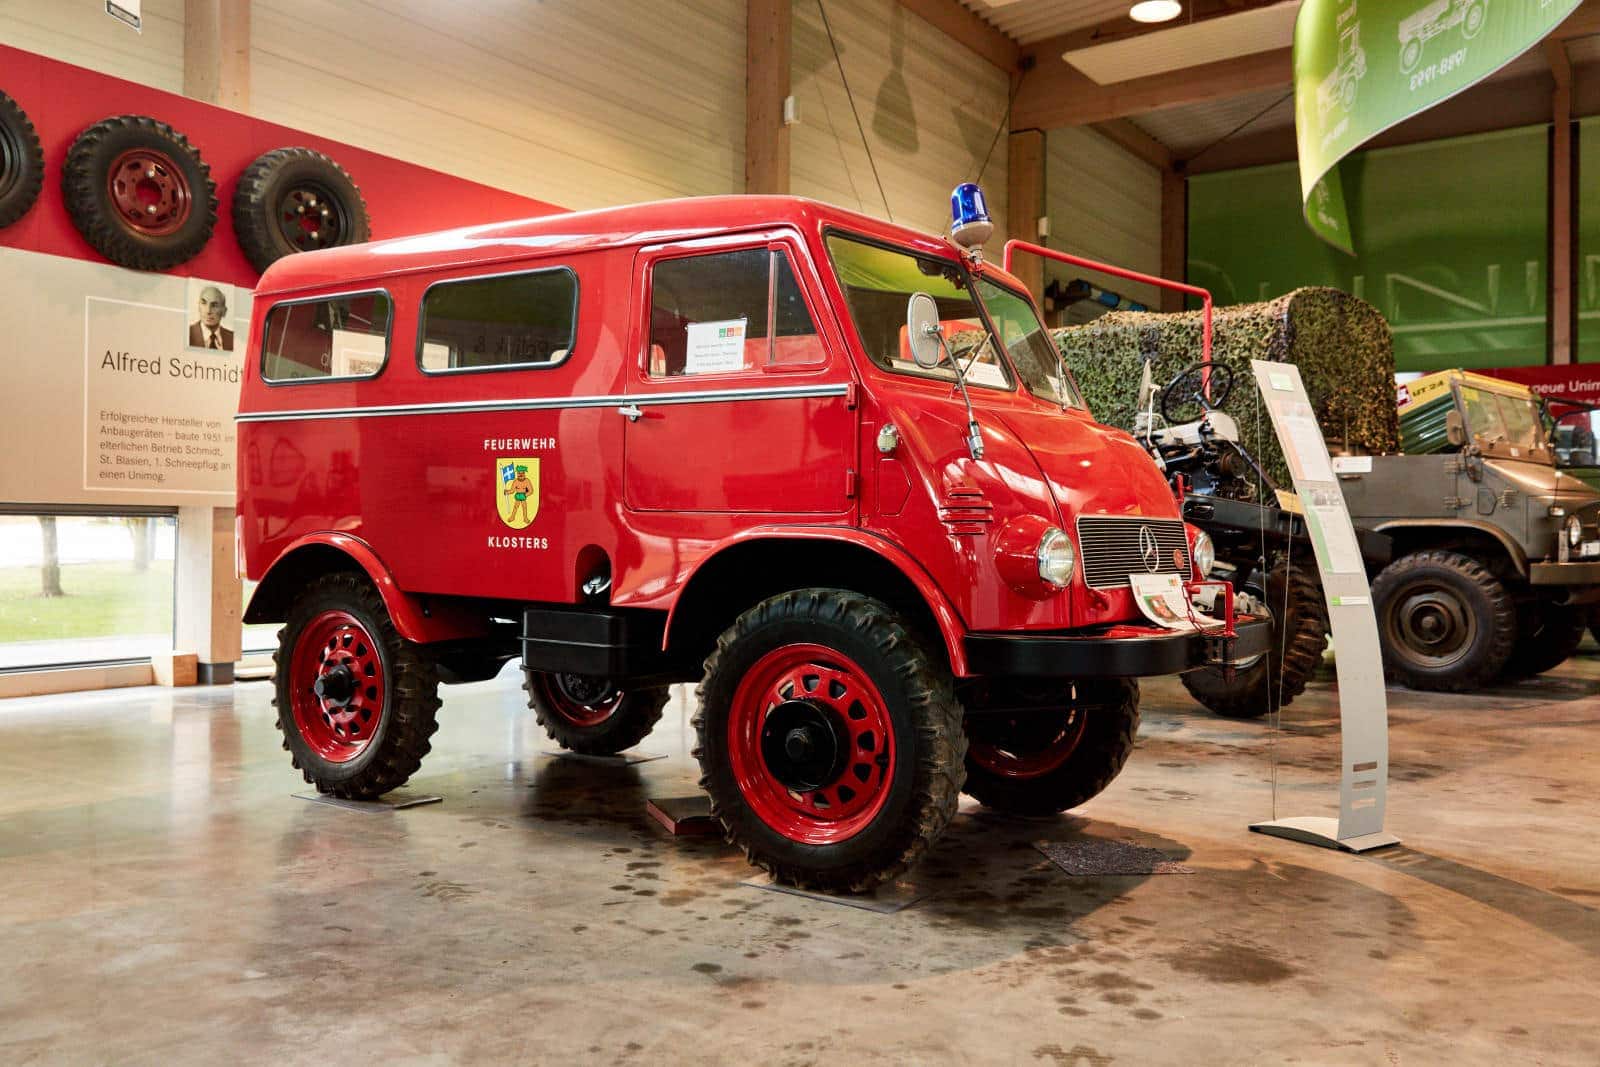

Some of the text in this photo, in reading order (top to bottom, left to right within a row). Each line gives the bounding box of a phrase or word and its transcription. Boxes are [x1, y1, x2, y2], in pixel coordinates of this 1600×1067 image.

[101, 350, 161, 375] Alfred
[100, 410, 221, 429] Erfolgreicher Hersteller von
[100, 425, 164, 440] Anbaugeräten
[175, 431, 200, 440] baute
[203, 432, 221, 441] 1951
[100, 441, 223, 457] elterlichen Betrieb Schmidt,
[484, 437, 556, 450] FEUERWEHR
[100, 454, 113, 465] St.
[116, 455, 152, 467] Blasien,
[165, 457, 218, 472] Schneepflug
[220, 462, 231, 470] an
[99, 470, 166, 483] einen Unimog.
[488, 536, 549, 549] KLOSTERS
